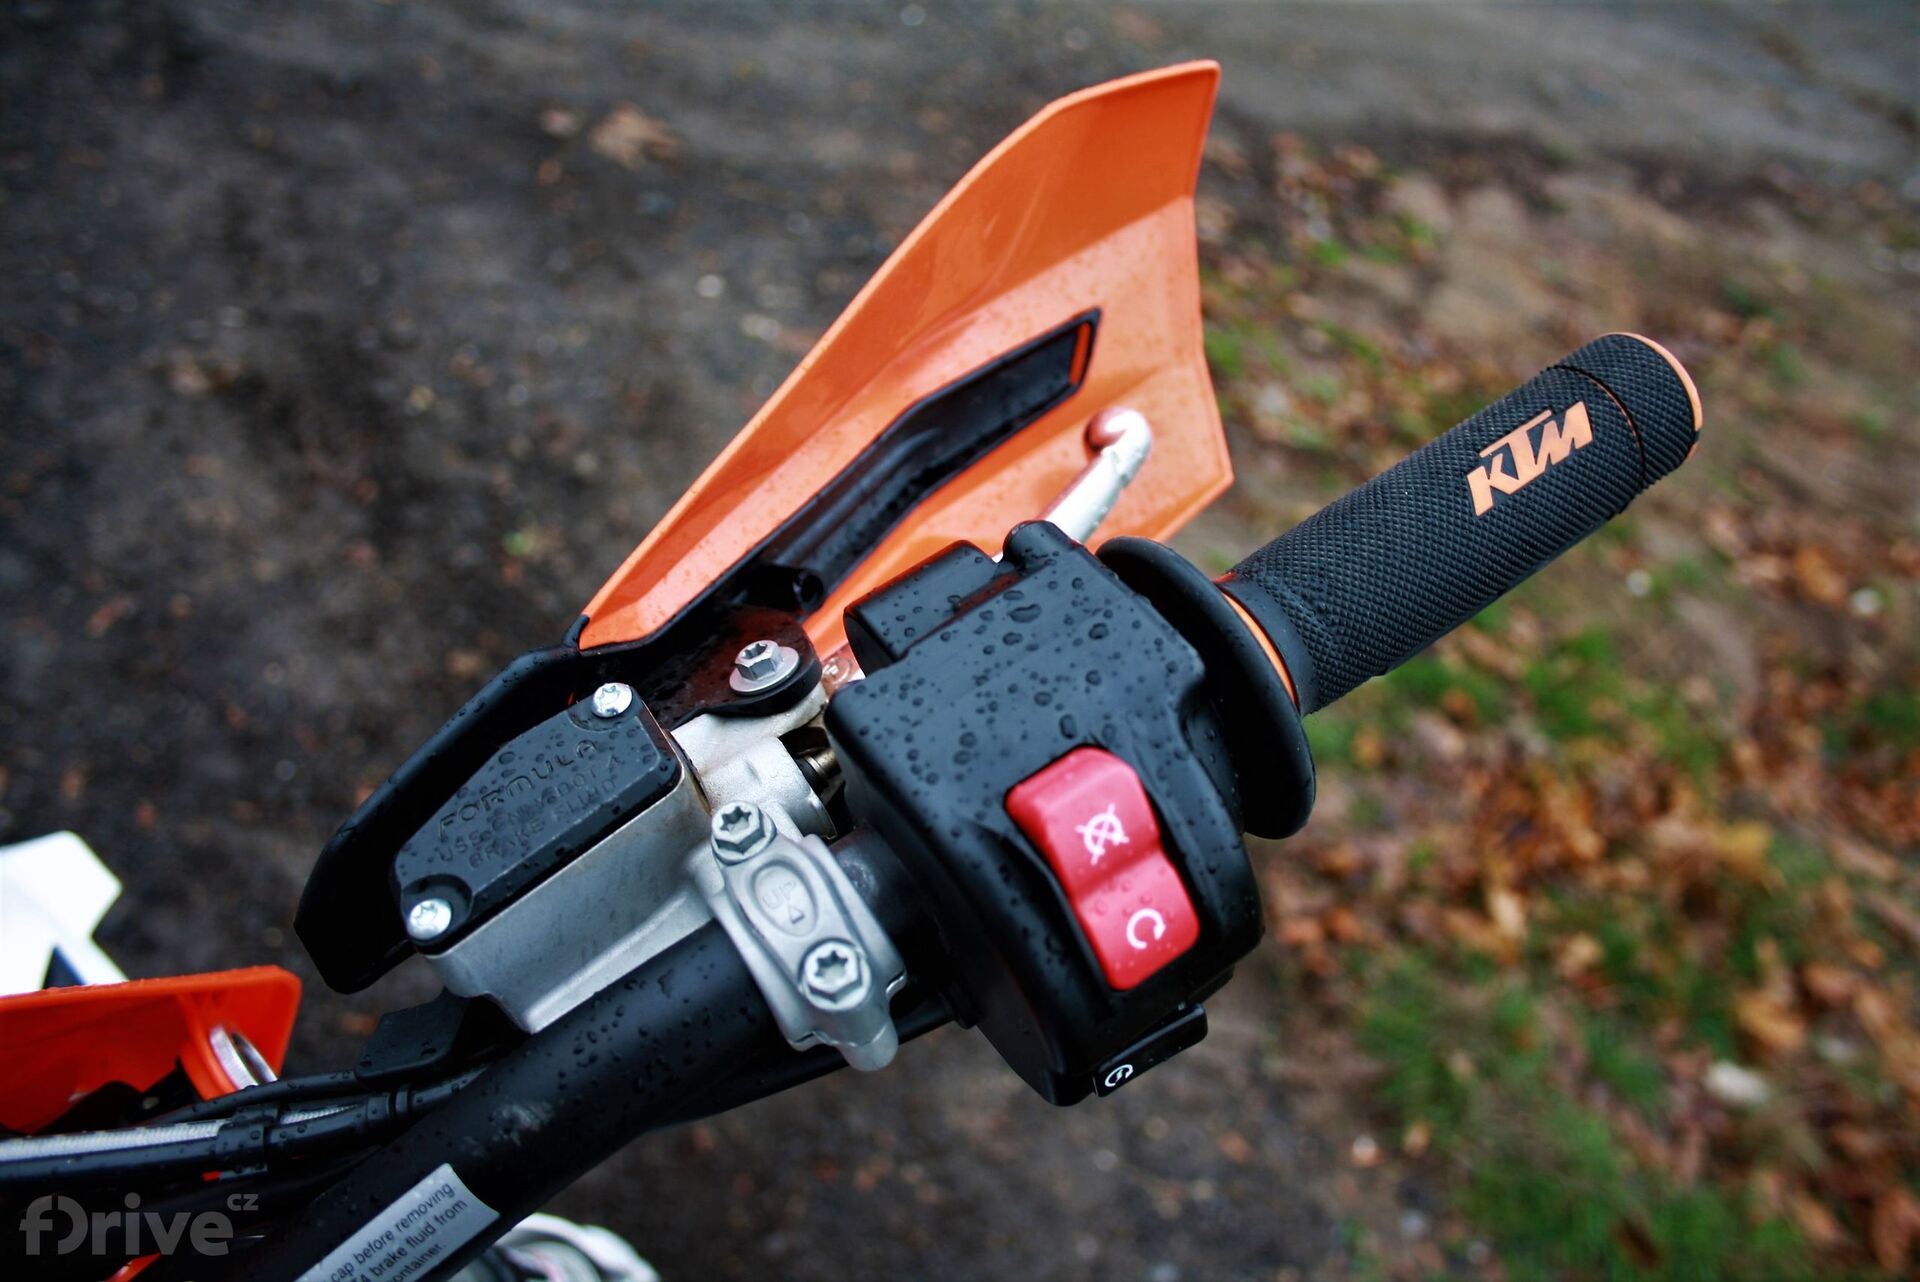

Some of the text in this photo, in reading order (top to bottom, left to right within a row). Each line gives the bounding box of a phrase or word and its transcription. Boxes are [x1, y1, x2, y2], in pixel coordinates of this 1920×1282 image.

[1466, 400, 1593, 517] KTM
[439, 738, 598, 843] FORMULA
[330, 1182, 456, 1282] cap before removing
[368, 1246, 409, 1278] brake
[405, 1222, 437, 1250] fluid
[433, 1199, 469, 1227] from
[385, 1241, 447, 1282] ontainer.
